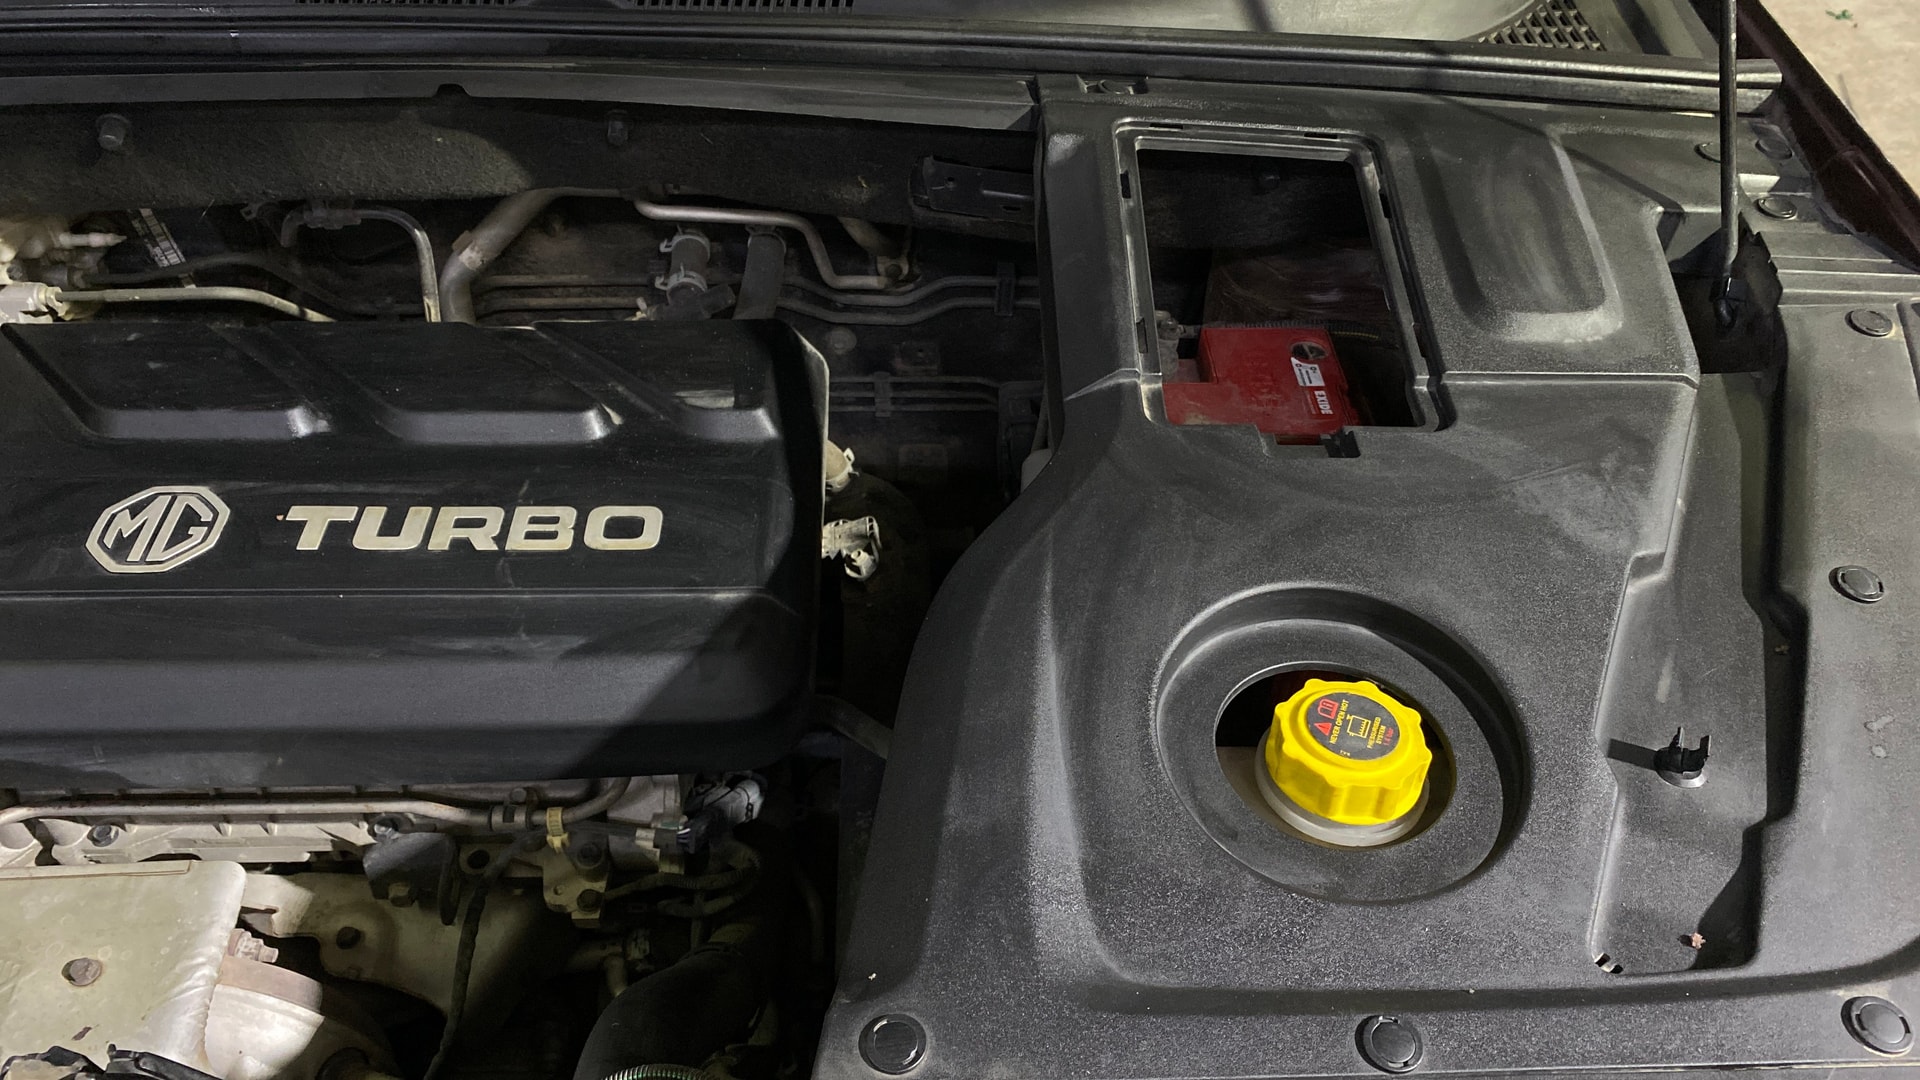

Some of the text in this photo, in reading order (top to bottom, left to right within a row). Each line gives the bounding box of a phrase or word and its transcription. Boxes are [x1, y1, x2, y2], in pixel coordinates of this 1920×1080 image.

[1313, 390, 1334, 415] EXIDE
[100, 491, 217, 567] MG
[285, 504, 664, 552] TURBO
[1329, 699, 1349, 745] NEVER OPEN HOT
[1376, 725, 1386, 745] SYSTEM
